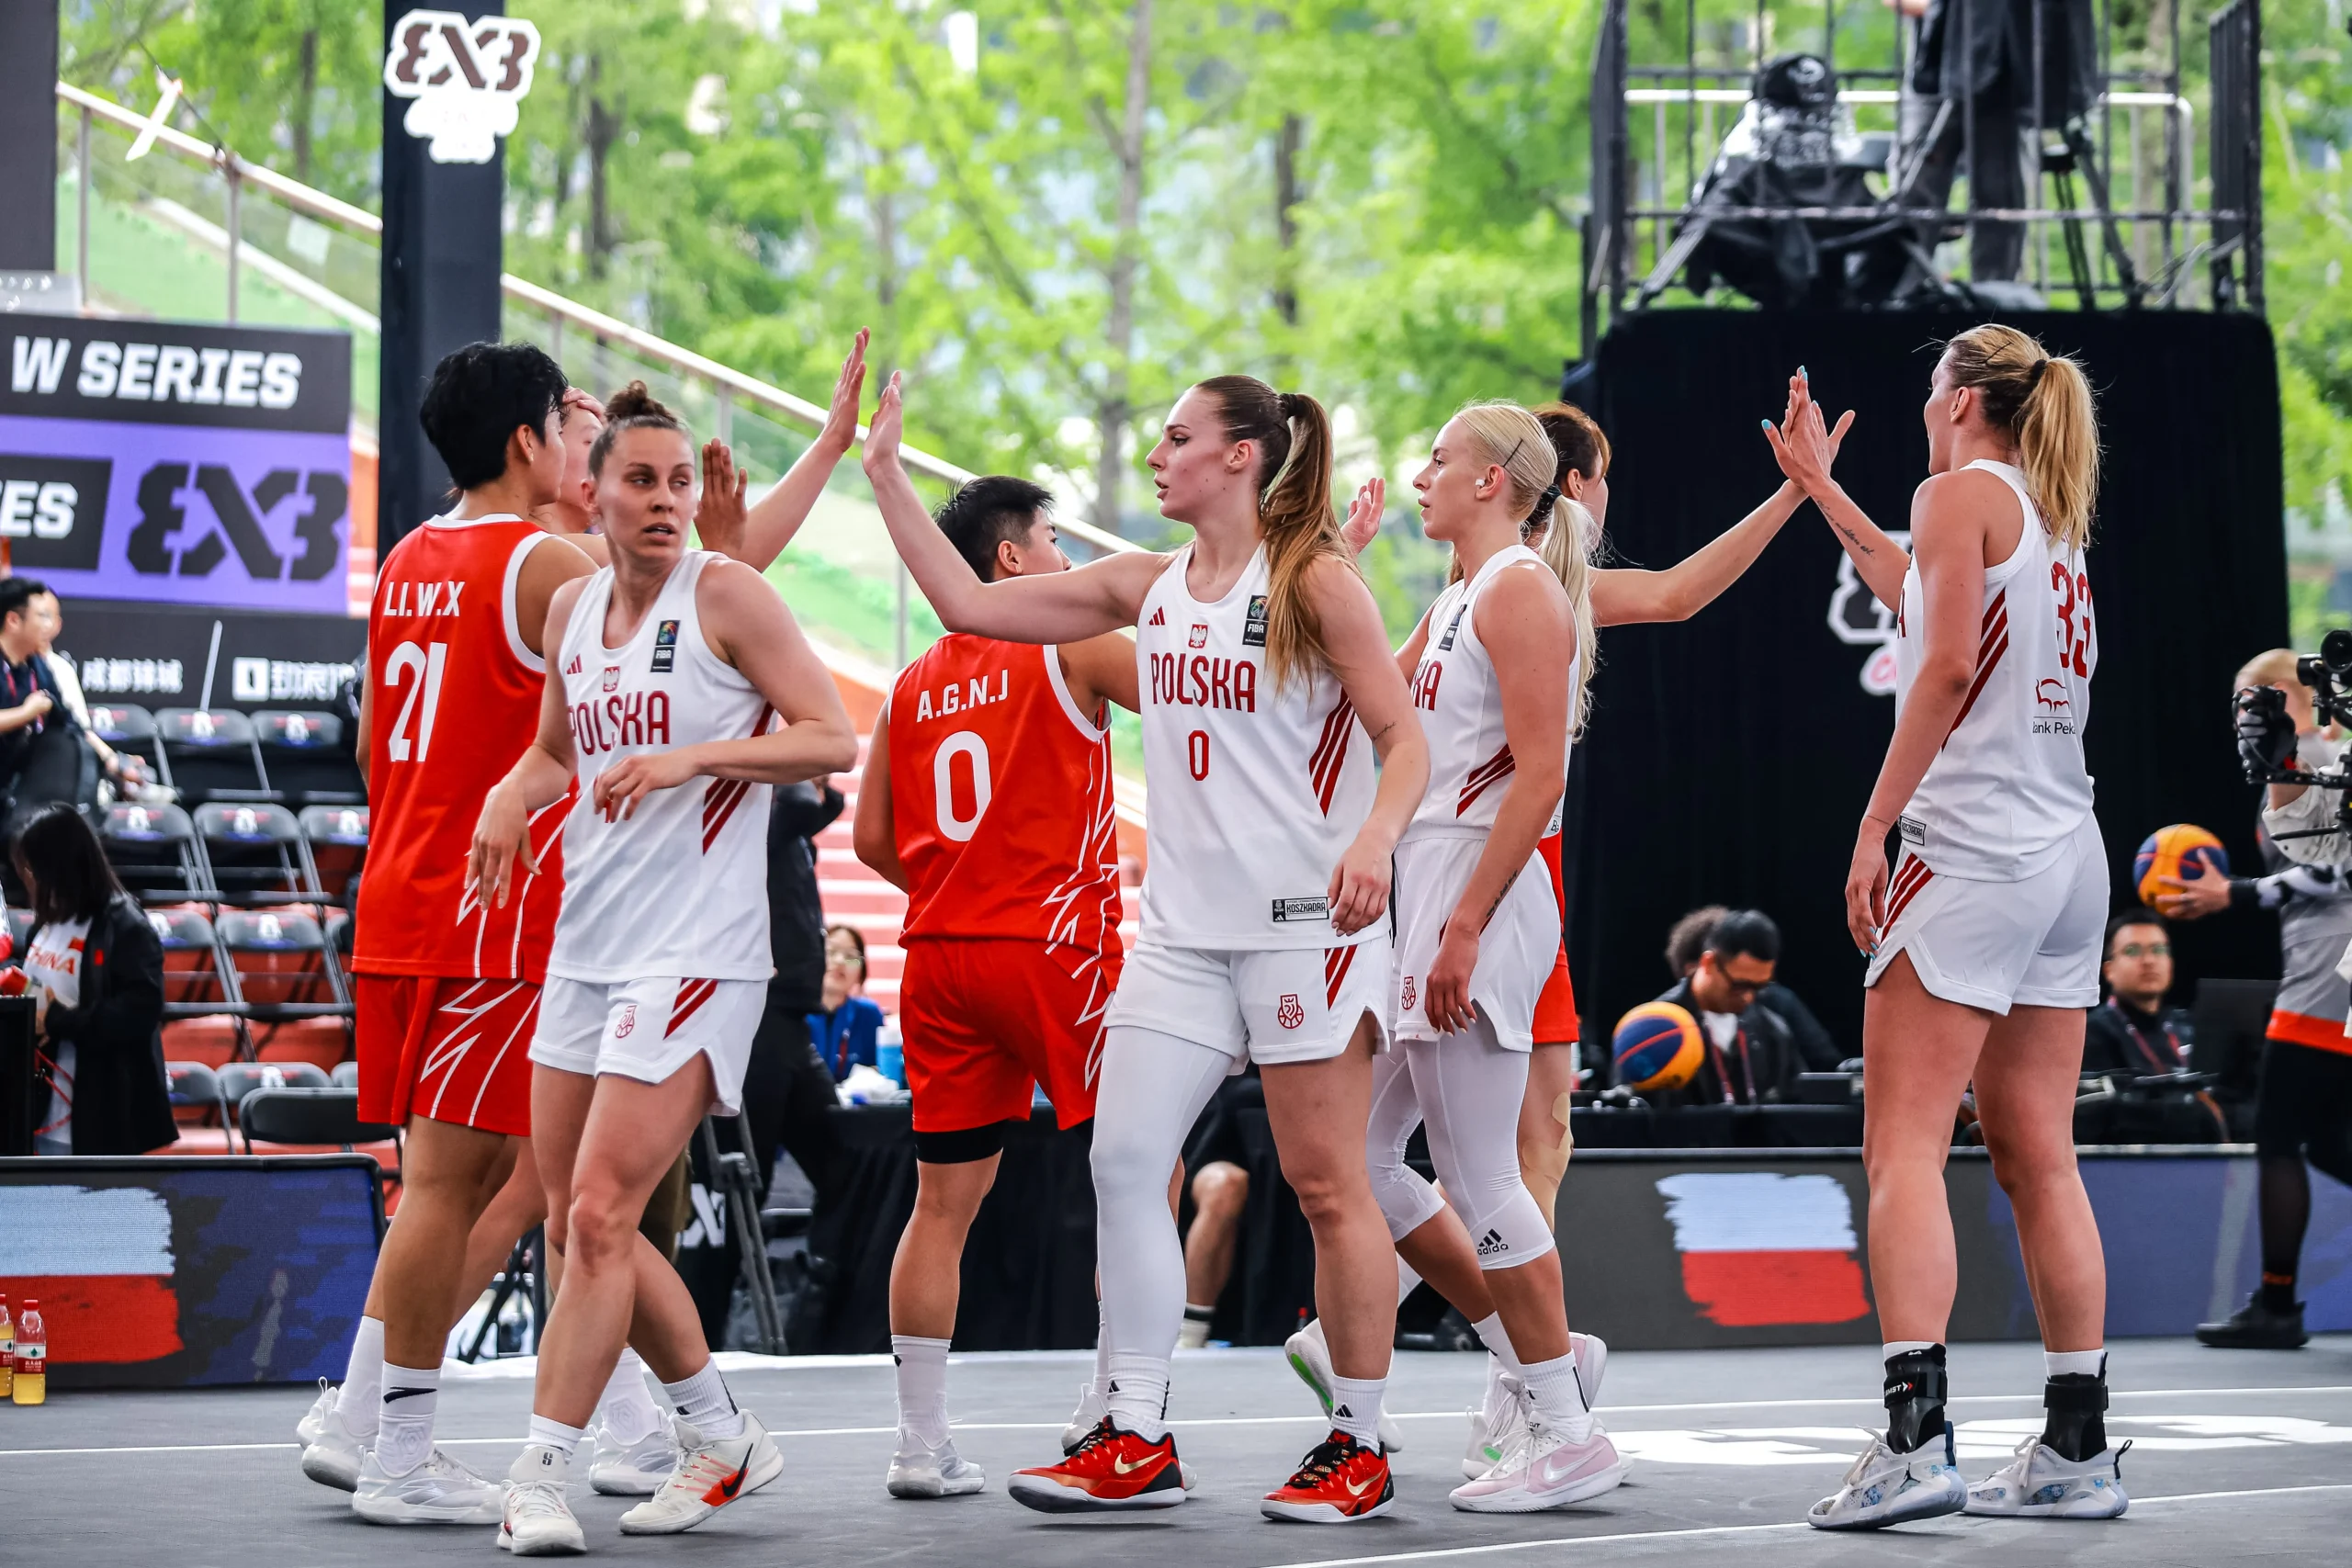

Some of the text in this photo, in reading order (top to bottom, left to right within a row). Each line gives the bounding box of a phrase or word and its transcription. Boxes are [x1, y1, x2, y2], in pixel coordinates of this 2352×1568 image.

[12, 336, 302, 410] W SERIES
[0, 479, 78, 539] ES
[384, 581, 465, 617] LI.W.X
[1248, 624, 1264, 634] FIBA
[2051, 561, 2092, 679] 33
[384, 640, 447, 762] 21
[917, 669, 1009, 723] A.G.N.J
[1150, 652, 1257, 713] POLSKA
[933, 730, 992, 842] 0
[1188, 730, 1210, 782] 0
